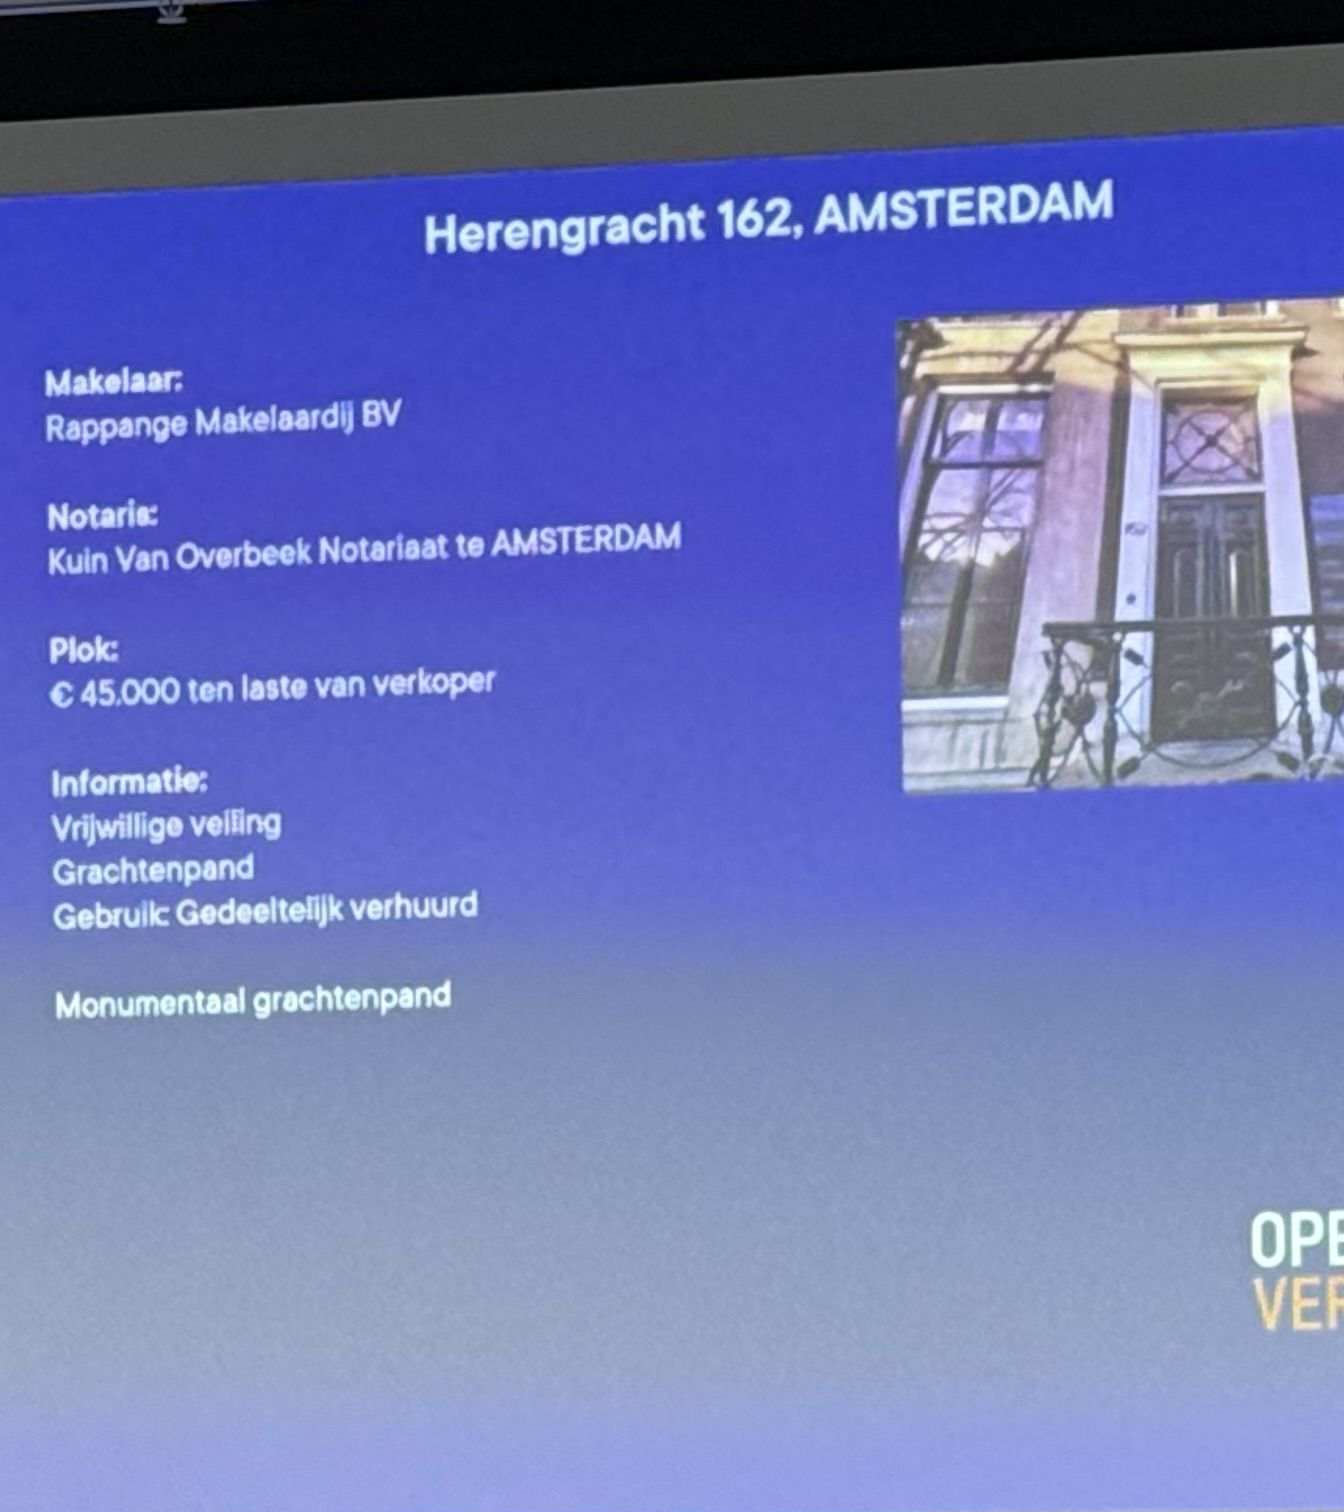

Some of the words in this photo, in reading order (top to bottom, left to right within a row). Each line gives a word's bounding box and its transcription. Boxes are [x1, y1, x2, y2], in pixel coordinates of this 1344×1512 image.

[424, 203, 706, 257] Herengracht
[717, 196, 805, 242] 162,
[813, 179, 1115, 236] AMSTERDAM
[44, 366, 184, 398] Makelaar:
[45, 413, 188, 446] Rappange
[194, 400, 355, 436] Makelaardij
[361, 398, 403, 428] BV
[47, 498, 159, 532] Notaris:
[47, 546, 108, 576] Kuin
[114, 544, 170, 574] Van
[174, 537, 313, 571] Overbeek
[318, 532, 449, 565] Notariaat
[454, 532, 485, 559] te
[490, 520, 682, 558] AMSTERDAM
[48, 634, 120, 664] Plok:
[48, 680, 75, 709] €
[79, 675, 182, 709] 45.000
[186, 677, 234, 704] ten
[240, 672, 308, 702] laste
[313, 674, 367, 700] van
[371, 665, 497, 701] verkoper
[51, 764, 209, 798] Informatie:
[50, 812, 185, 847] Vrijwillige
[189, 807, 283, 842] veiling
[52, 853, 255, 887] Grachtenpand
[175, 894, 345, 928] Gedeeltelijk
[348, 889, 479, 922] verhuurd
[55, 986, 246, 1020] Monumentaal
[252, 979, 452, 1020] grachtenpand
